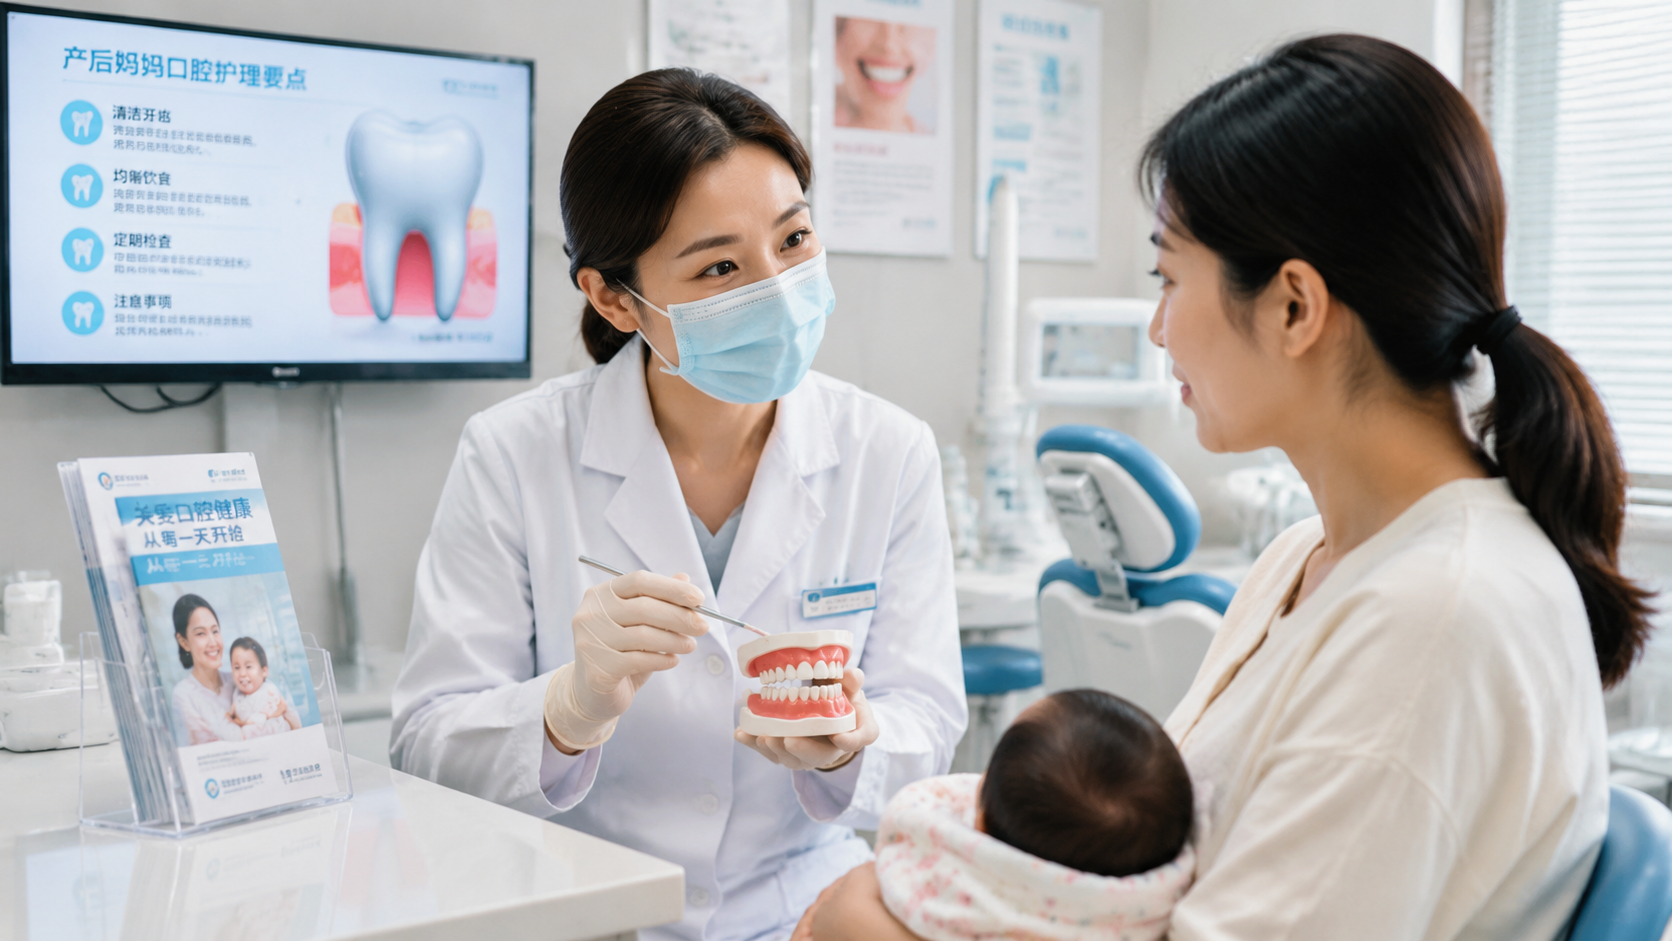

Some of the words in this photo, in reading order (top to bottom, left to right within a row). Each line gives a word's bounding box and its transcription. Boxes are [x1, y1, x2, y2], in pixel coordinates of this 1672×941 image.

[63, 46, 307, 90] 产后妈妈口腔护理要点
